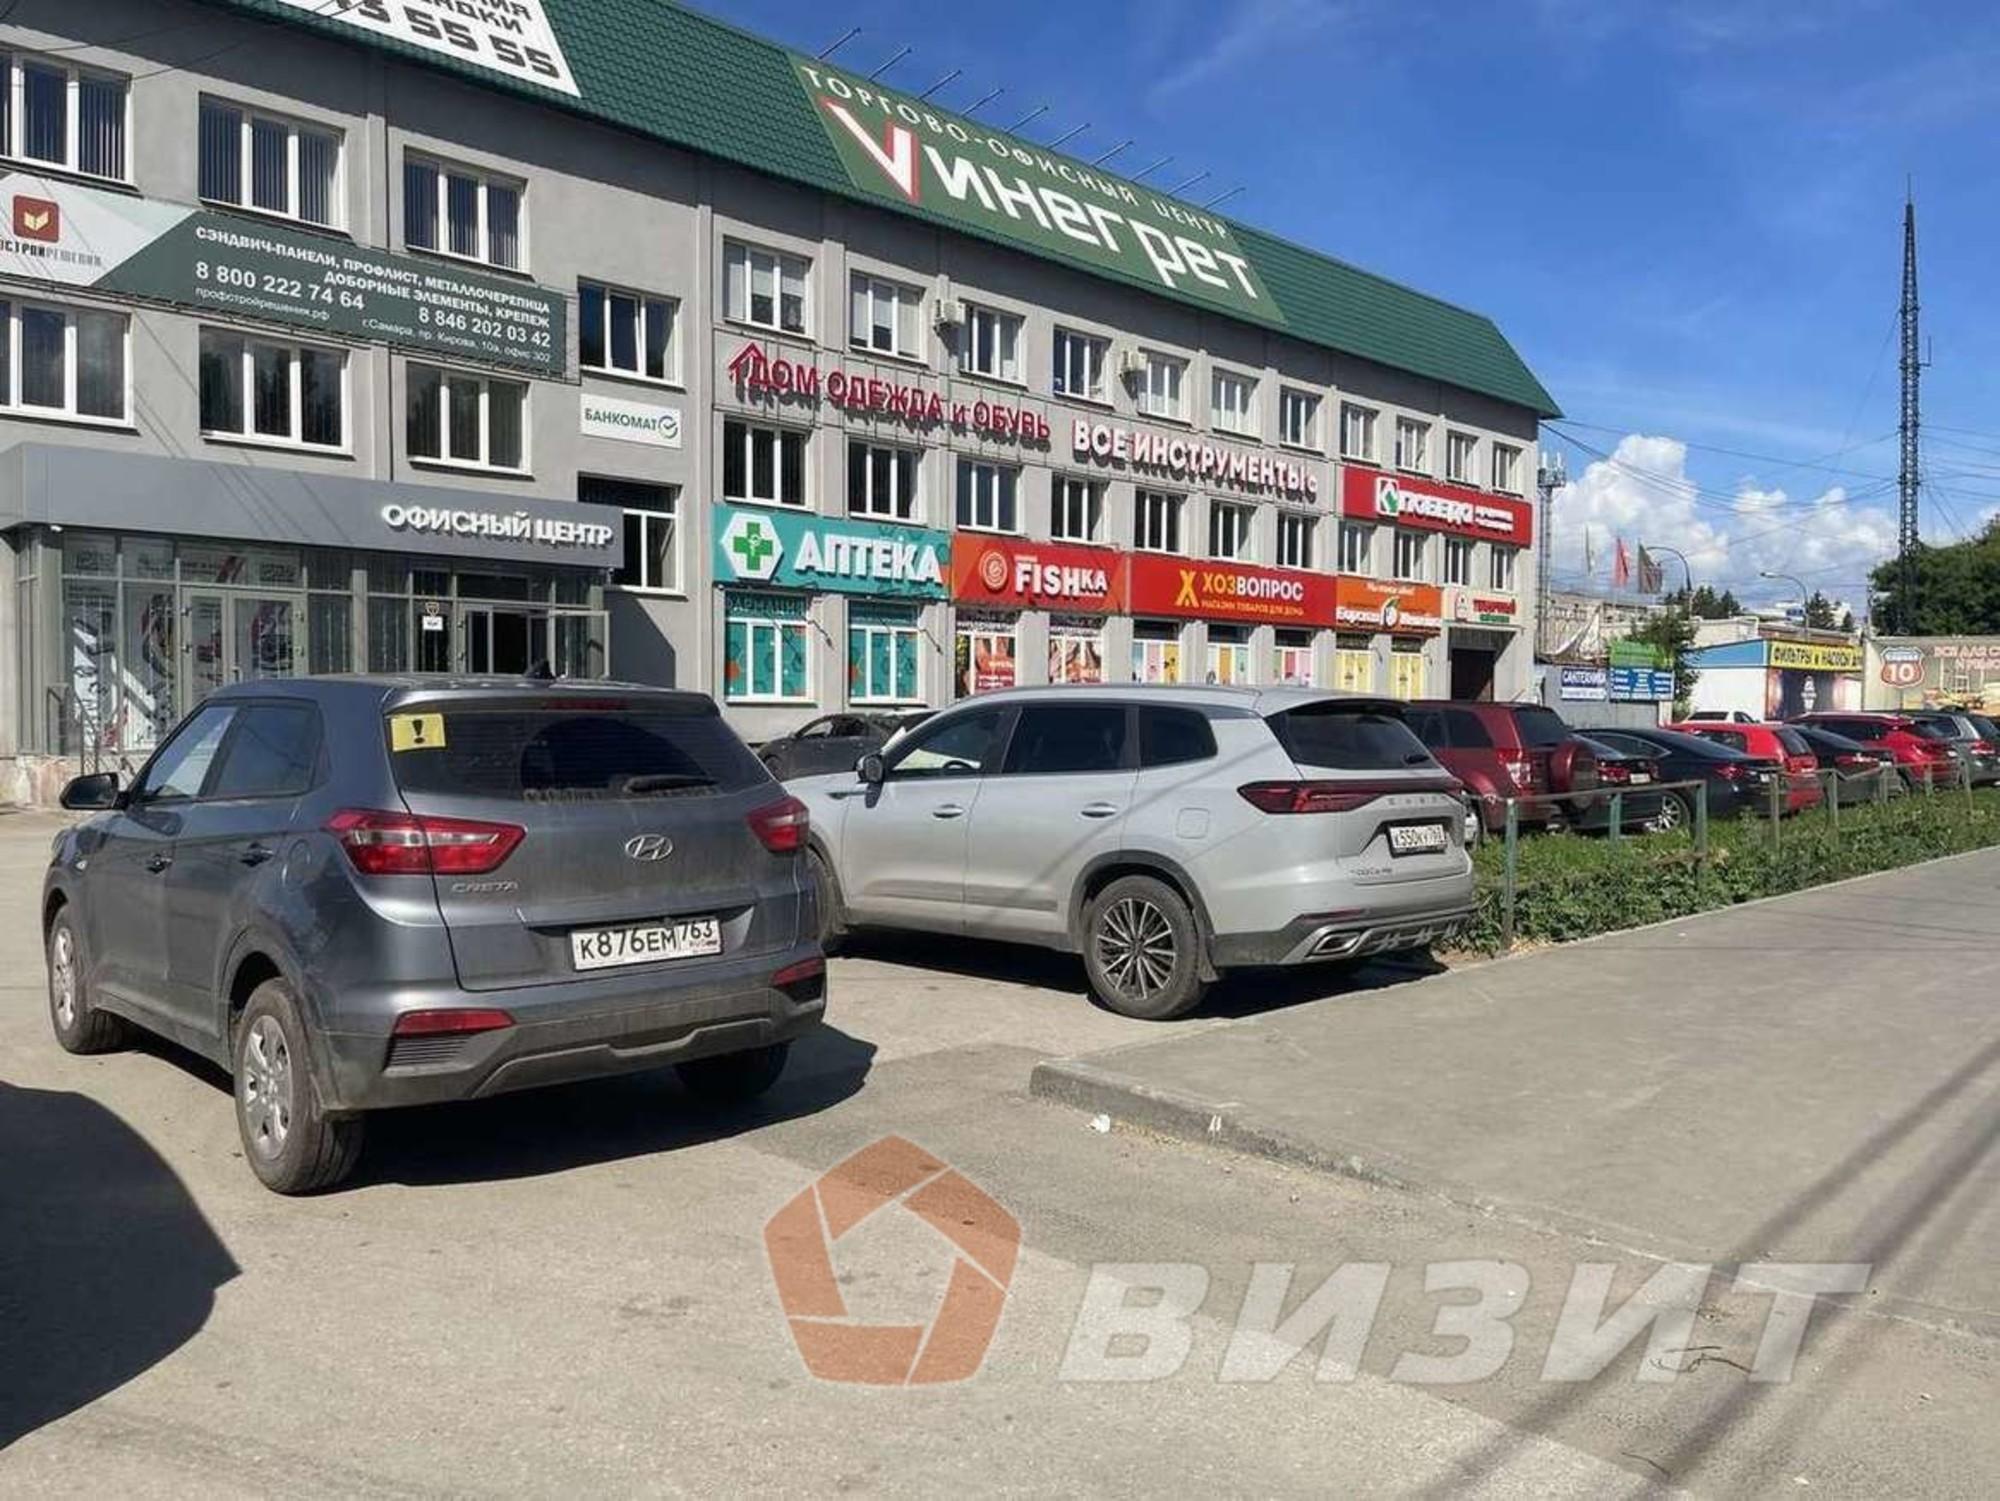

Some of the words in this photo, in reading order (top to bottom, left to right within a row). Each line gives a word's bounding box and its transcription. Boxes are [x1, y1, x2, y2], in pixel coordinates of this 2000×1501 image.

[336, 0, 391, 23] 3
[403, 5, 480, 51] 55
[489, 34, 561, 79] 55
[801, 66, 1140, 206] ТОРГОВО-ОФИСНЫЙ
[1152, 199, 1230, 239] ЦЕНТР
[195, 226, 340, 269] СЭНДВИЧ-ПАНЕЛИ,
[343, 258, 422, 287] ПРОФЛИСТ,
[425, 276, 551, 314] МЕТАЛЛОЧЕРЕПИЦА
[195, 261, 209, 280] 8
[216, 265, 256, 289] 800
[263, 275, 302, 298] 222
[308, 284, 333, 305] 74
[340, 292, 365, 311] 64
[324, 270, 410, 299] ДОБОРНЫЕ
[414, 289, 493, 316] ЭЛЕМЕНТЫ,
[495, 306, 551, 329] КРЕПЕЖ
[418, 307, 430, 324] 8
[434, 309, 467, 332] 846
[471, 317, 502, 339] 202
[506, 324, 527, 343] 03
[531, 330, 551, 348] 42
[749, 356, 818, 393] ДОМ
[827, 371, 943, 420] ОДЕЖДА
[973, 400, 1052, 440] ОБУВЬ
[584, 407, 657, 431] БАНКОМАТ
[1072, 418, 1127, 459] ВСЕ
[381, 504, 531, 539] ОФИСНЫЙ
[534, 519, 613, 546] ЦЕНТР
[794, 530, 944, 585] АПТЕКА
[1015, 561, 1108, 597] FISHKA
[1202, 571, 1304, 602] ХОЗВОПРОС
[1888, 662, 1914, 682] 10
[451, 880, 519, 893] CRETA
[580, 927, 677, 961] К876ЕМ
[678, 920, 713, 941] 763
